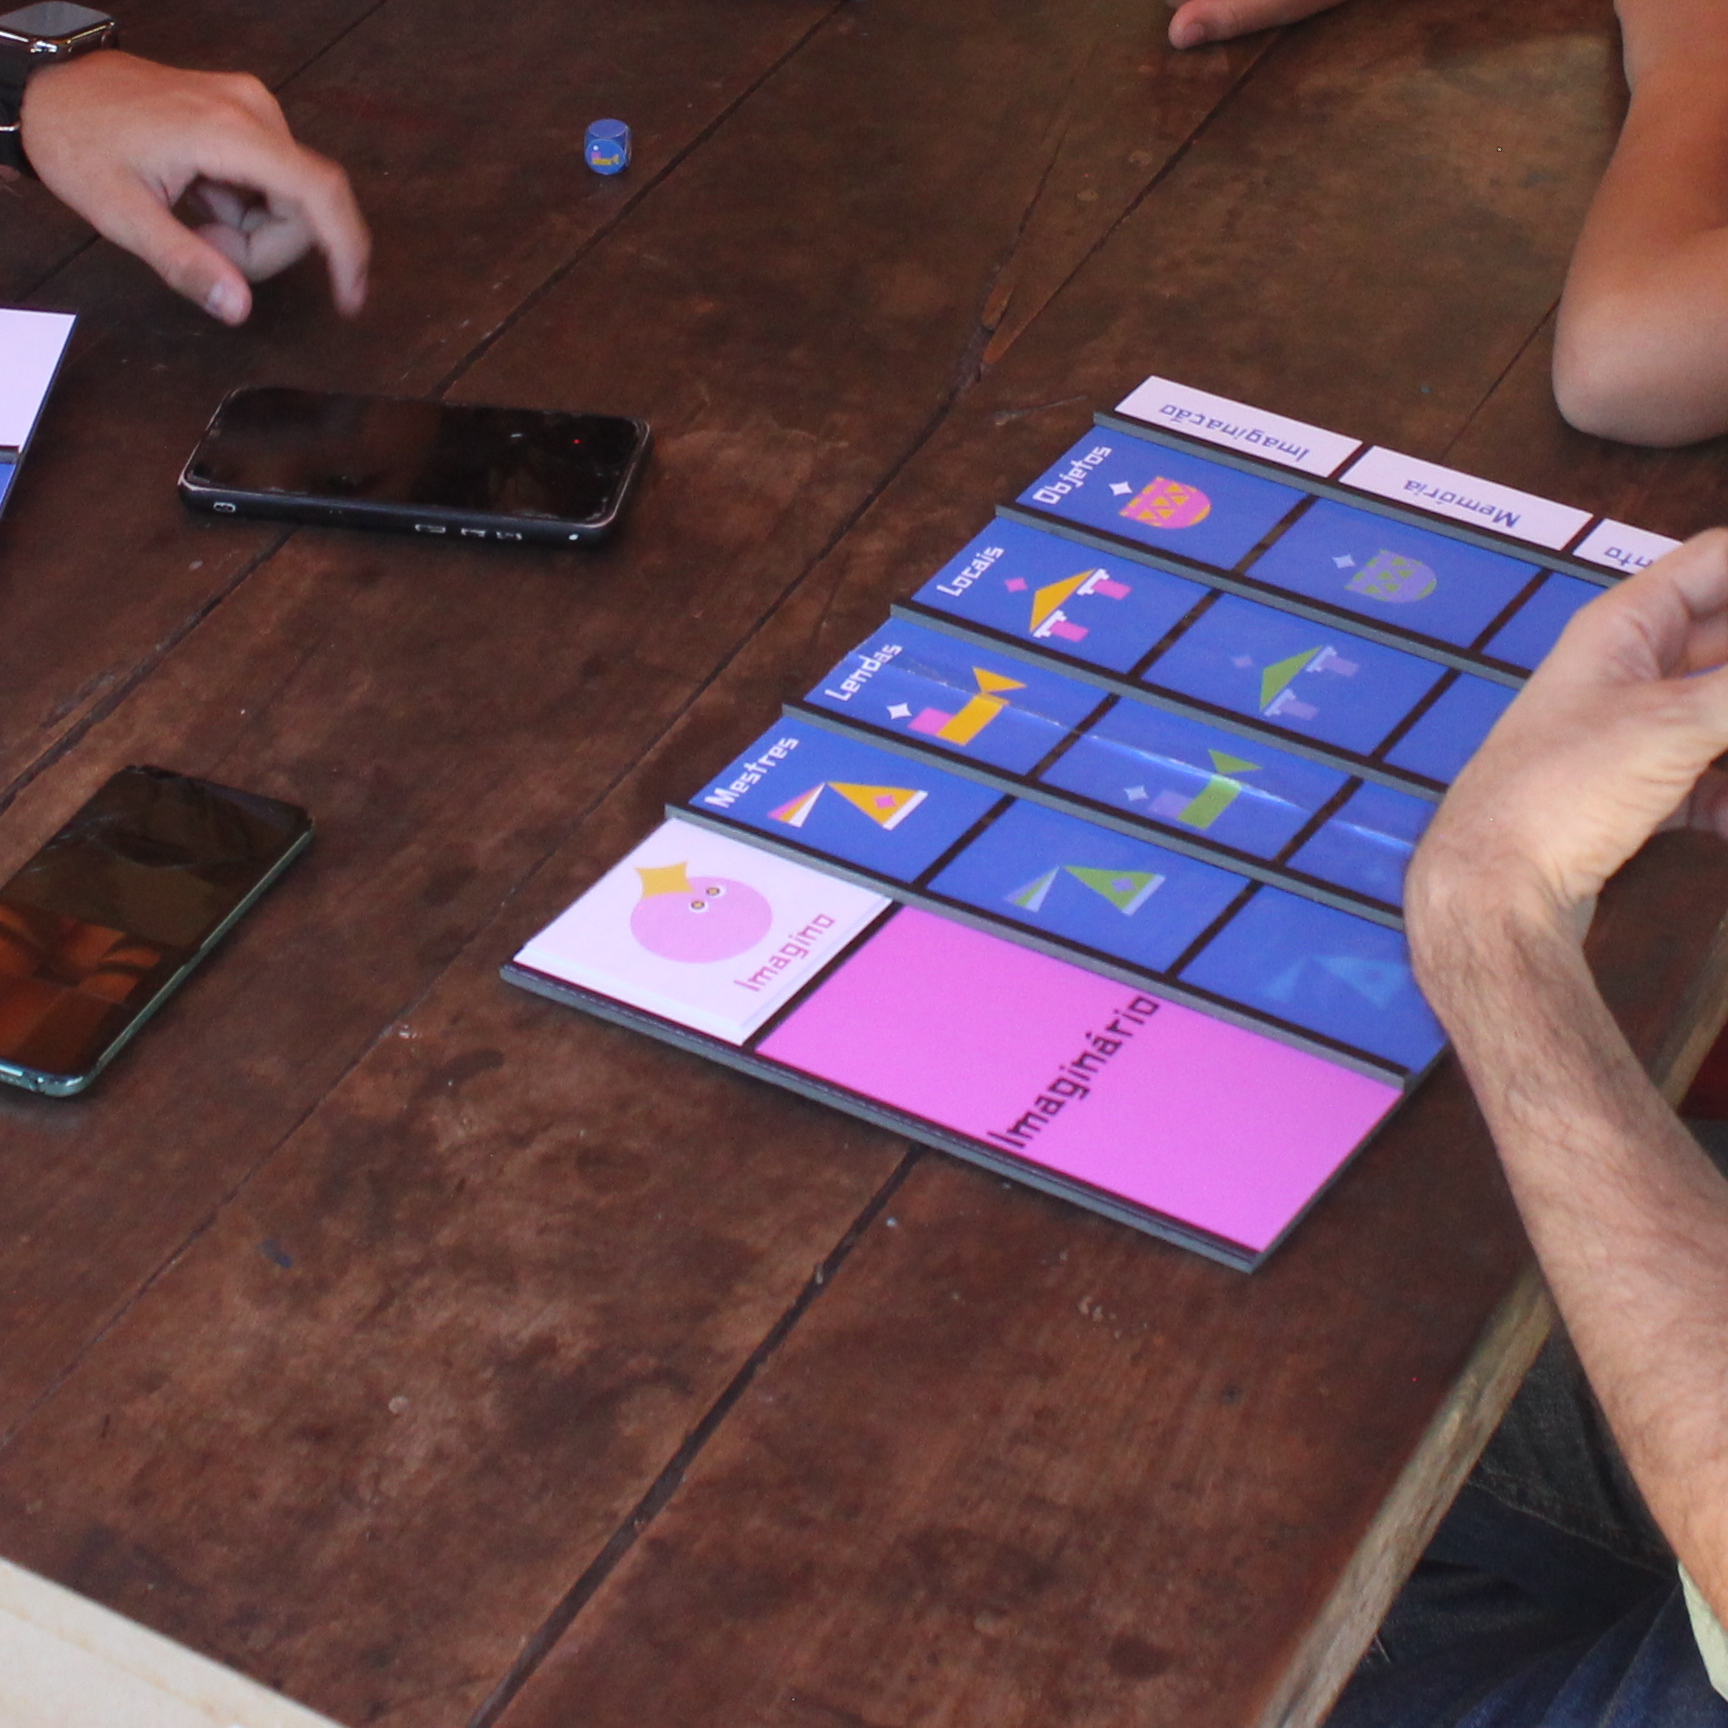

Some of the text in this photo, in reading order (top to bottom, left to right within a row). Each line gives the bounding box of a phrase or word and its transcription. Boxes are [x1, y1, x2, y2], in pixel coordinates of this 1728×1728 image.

[1159, 403, 1310, 462] Imaginação
[1032, 446, 1113, 506] Objetos
[1402, 478, 1522, 530] Memória
[936, 544, 1005, 598] Locais
[824, 643, 903, 702] Lendas
[703, 735, 800, 809] Mestres
[733, 913, 836, 993] Imagino
[987, 994, 1162, 1150] Imaginário
